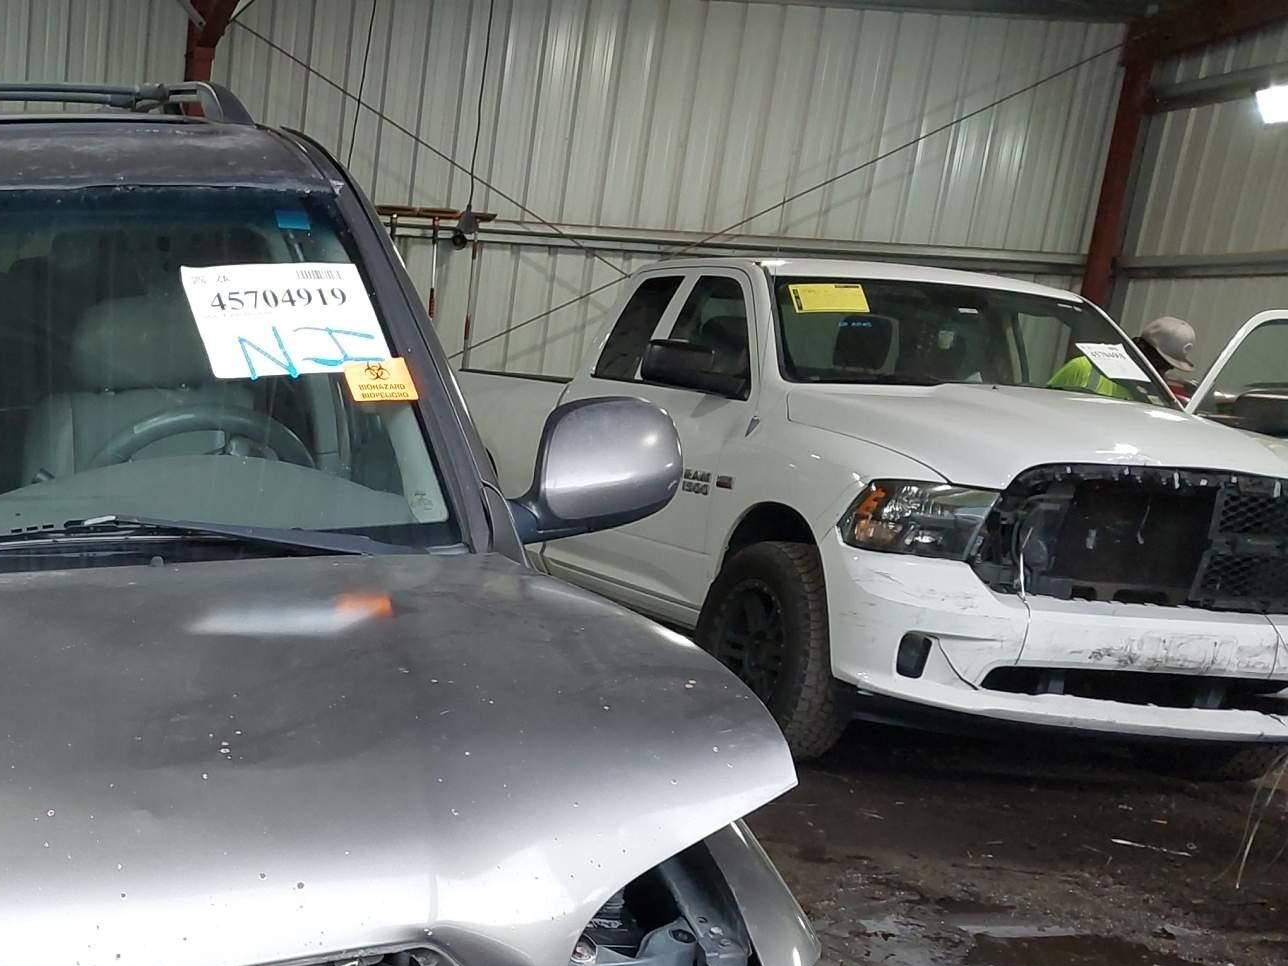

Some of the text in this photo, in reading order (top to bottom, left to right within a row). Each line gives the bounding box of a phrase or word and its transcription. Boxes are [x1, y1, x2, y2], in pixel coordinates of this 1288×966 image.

[210, 287, 347, 311] 45704919
[358, 383, 406, 391] BIOHAZARD
[361, 391, 410, 399] BIOPELIGRO
[683, 469, 712, 483] RAM
